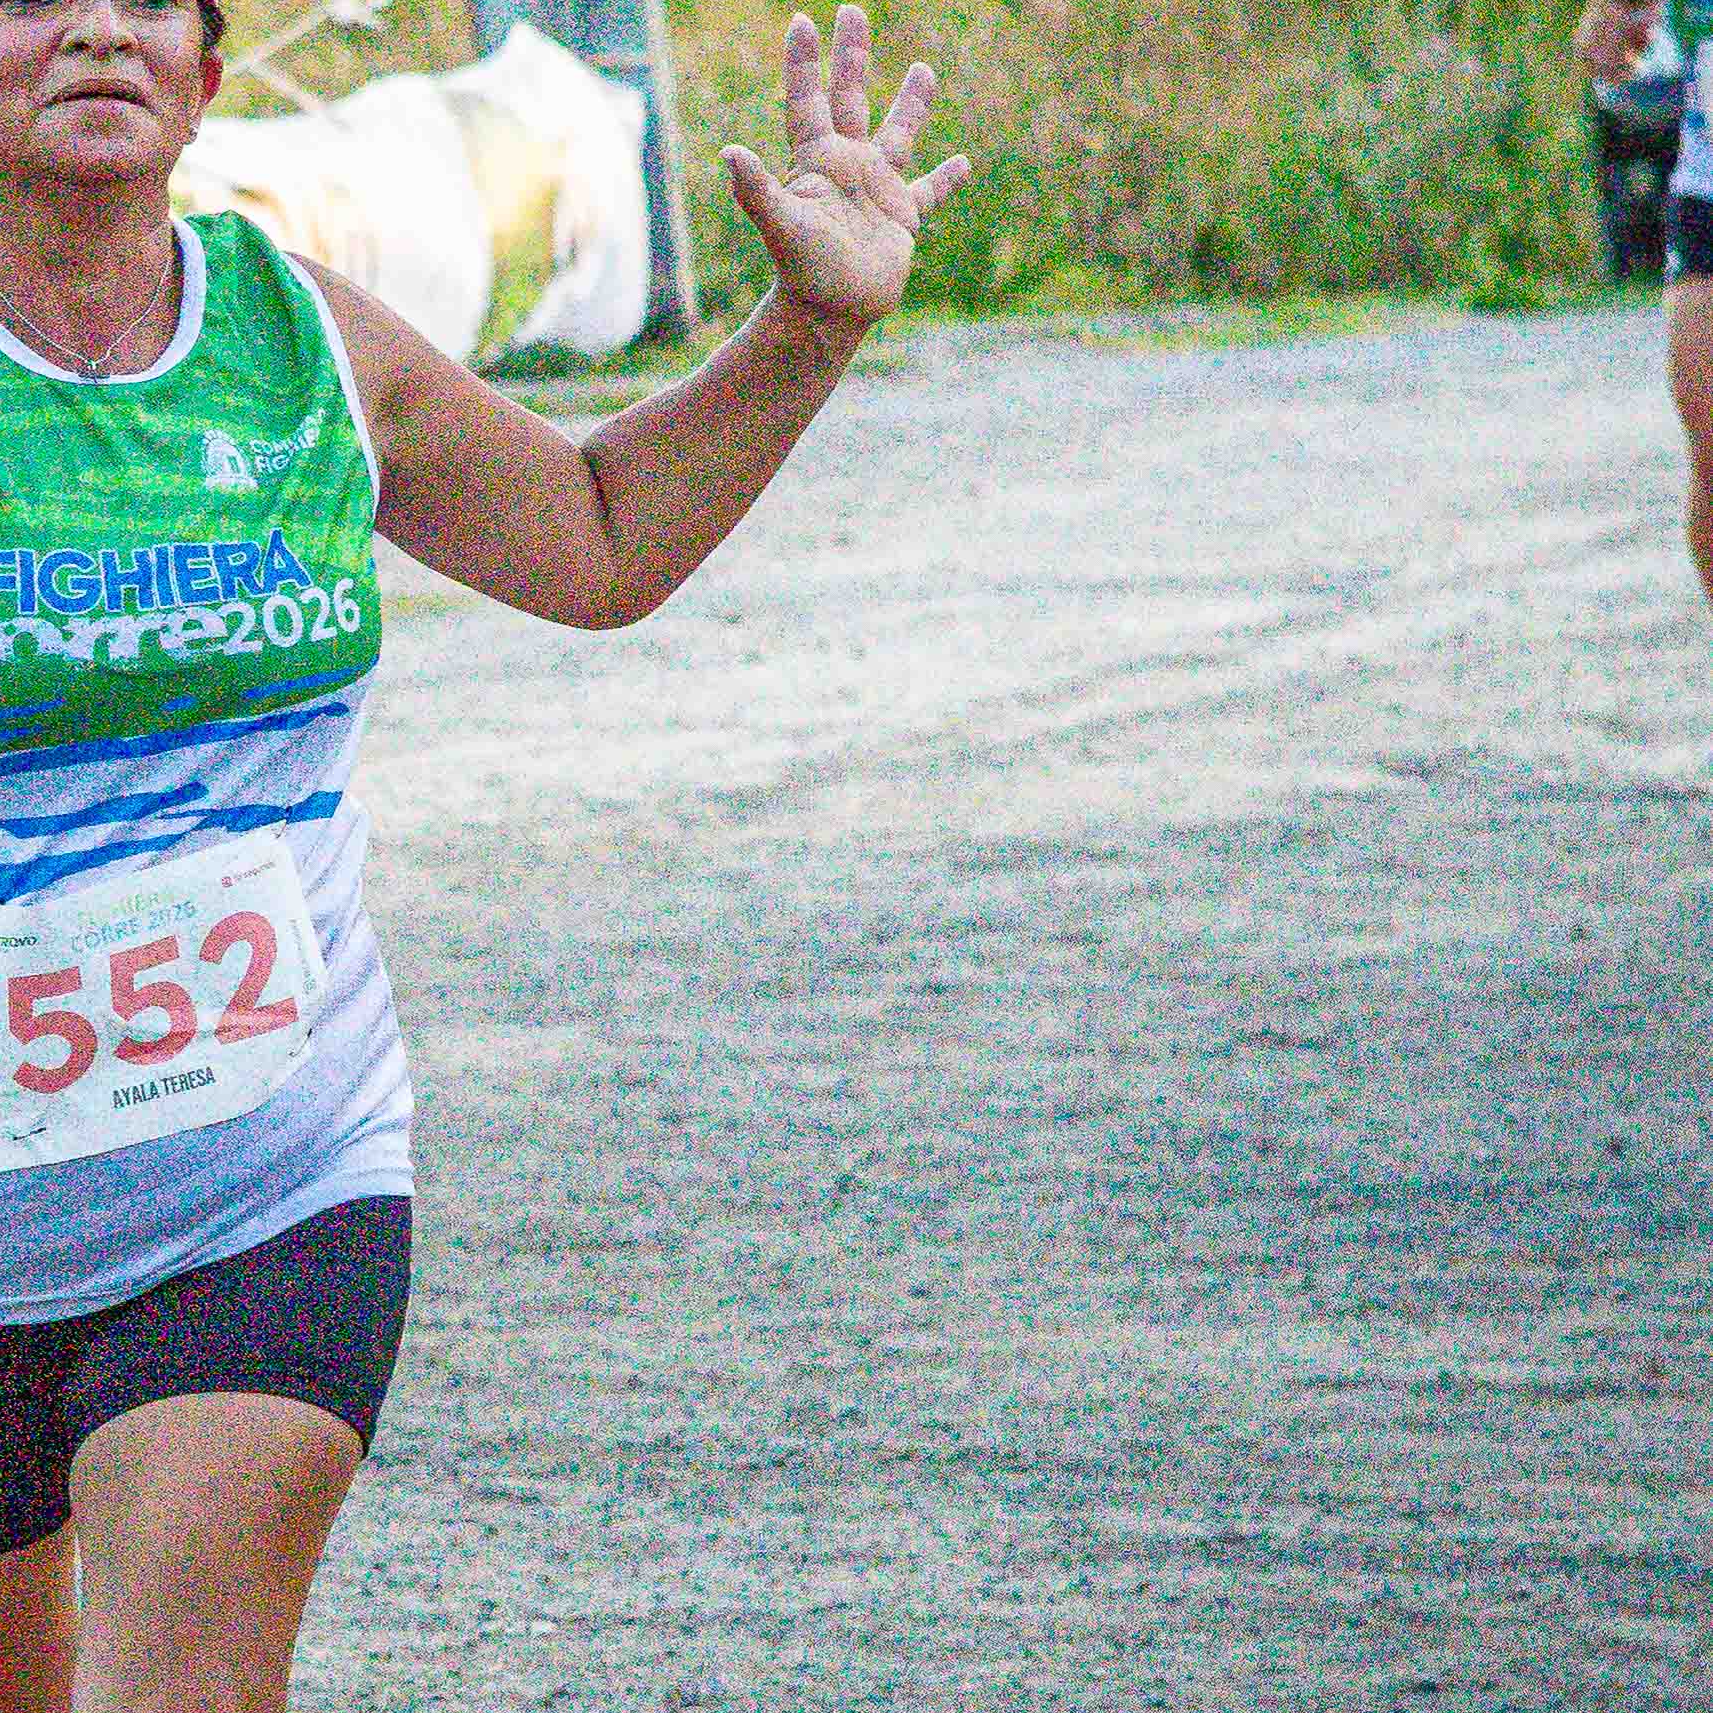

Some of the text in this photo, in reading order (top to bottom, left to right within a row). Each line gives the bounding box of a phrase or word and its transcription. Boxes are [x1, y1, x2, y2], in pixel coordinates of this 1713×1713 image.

[70, 916, 142, 954] CORRE
[6, 910, 299, 1095] 552
[111, 1066, 216, 1109] AYALA TERESA
